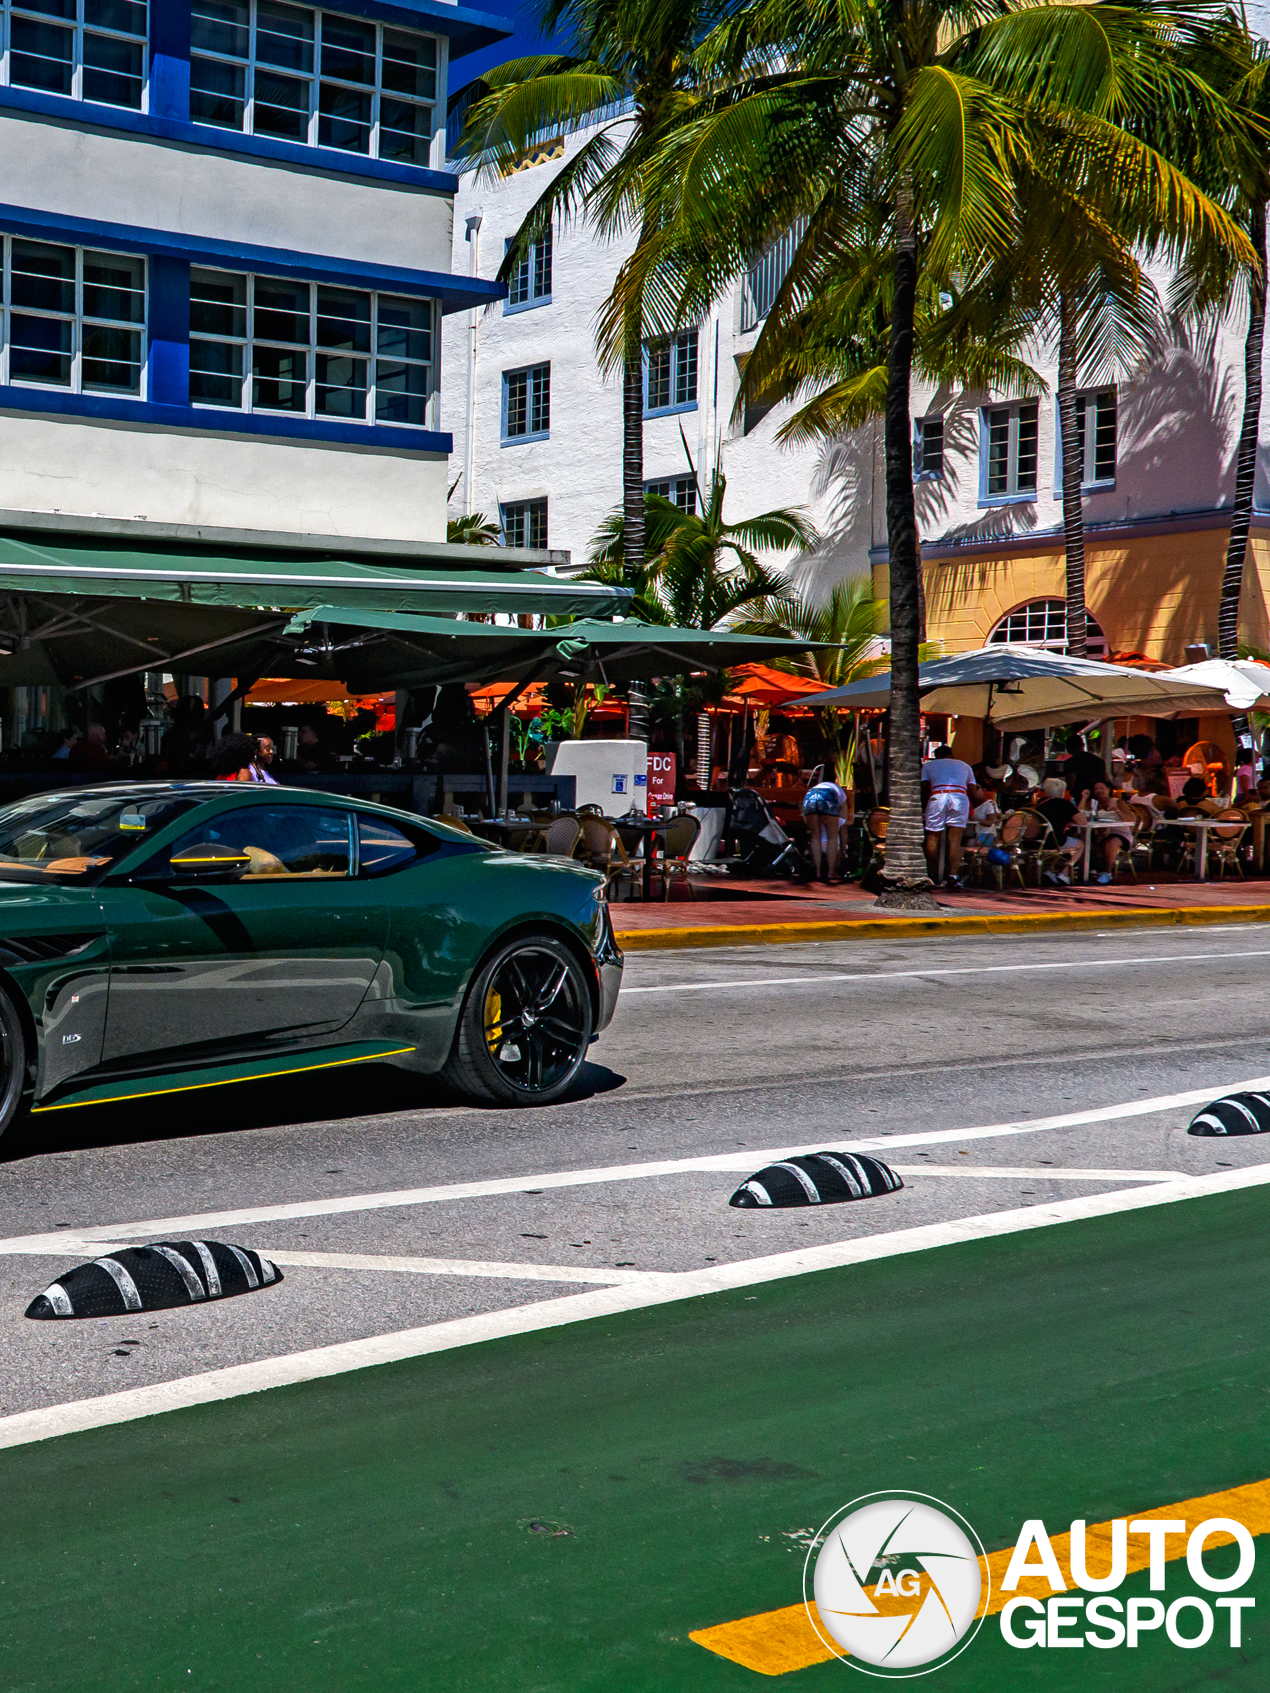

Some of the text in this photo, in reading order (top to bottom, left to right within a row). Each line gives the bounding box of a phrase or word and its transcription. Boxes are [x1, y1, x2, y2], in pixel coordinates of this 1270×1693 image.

[646, 756, 671, 771] FDC
[652, 776, 663, 784] For
[663, 792, 674, 800] Drive
